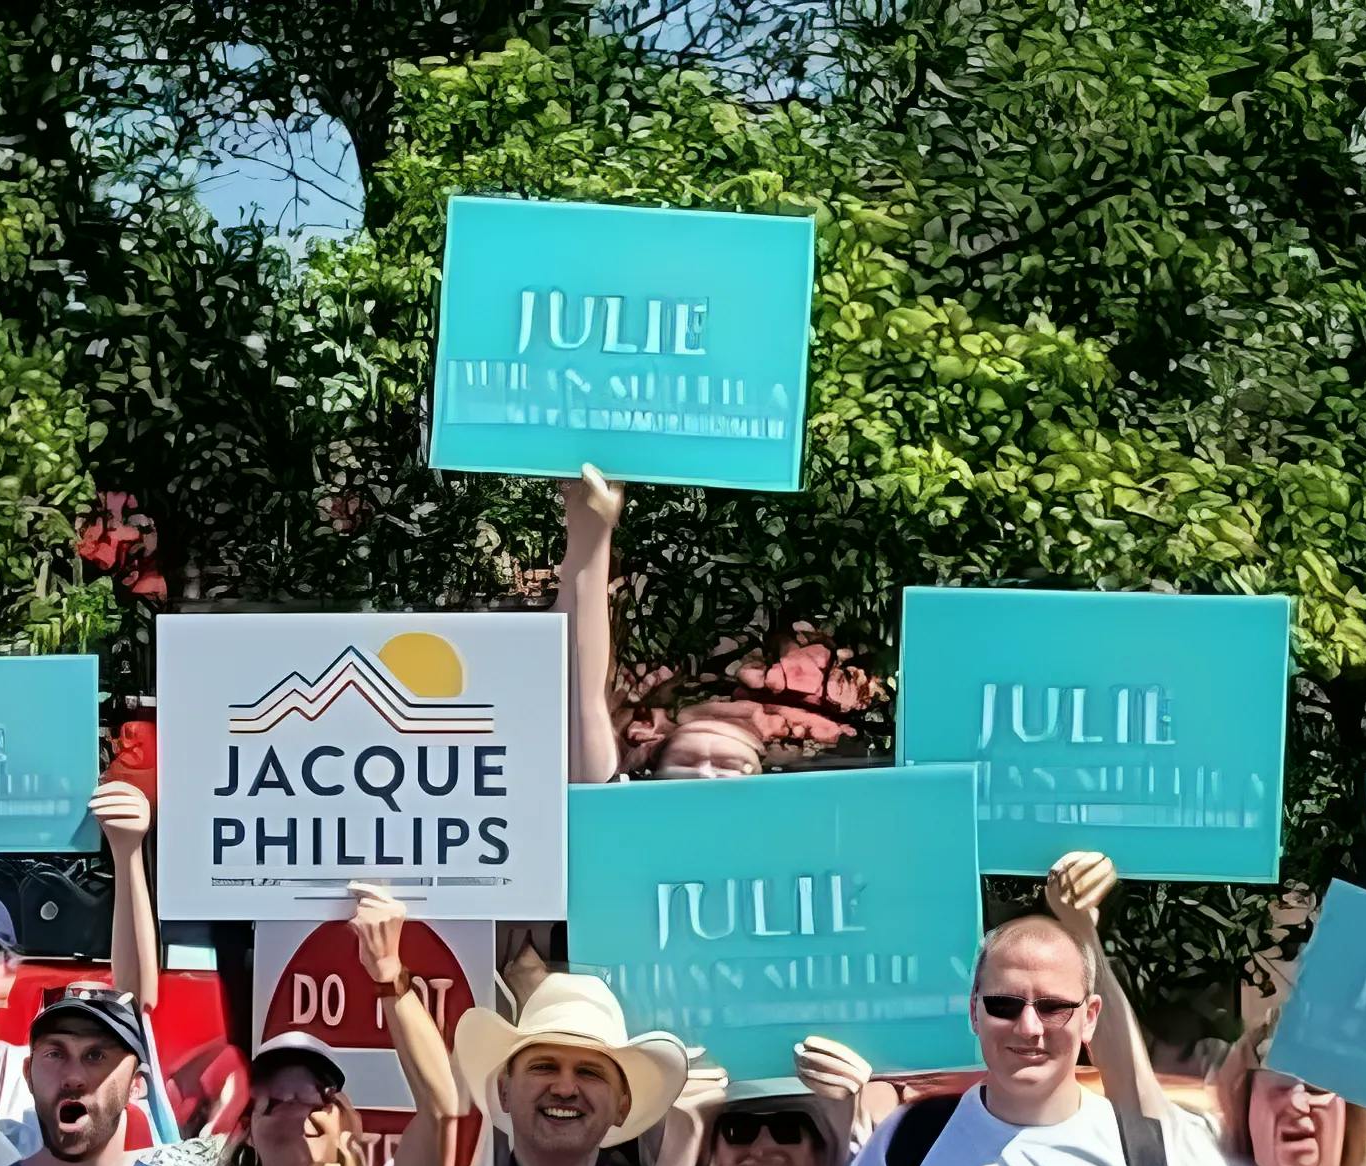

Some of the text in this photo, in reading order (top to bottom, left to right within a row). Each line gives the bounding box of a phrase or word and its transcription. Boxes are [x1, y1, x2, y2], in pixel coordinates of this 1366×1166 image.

[518, 289, 709, 356] JULIE
[212, 744, 508, 813] JACQUE
[211, 815, 511, 867] PHILLIPS
[289, 973, 346, 1027] DO
